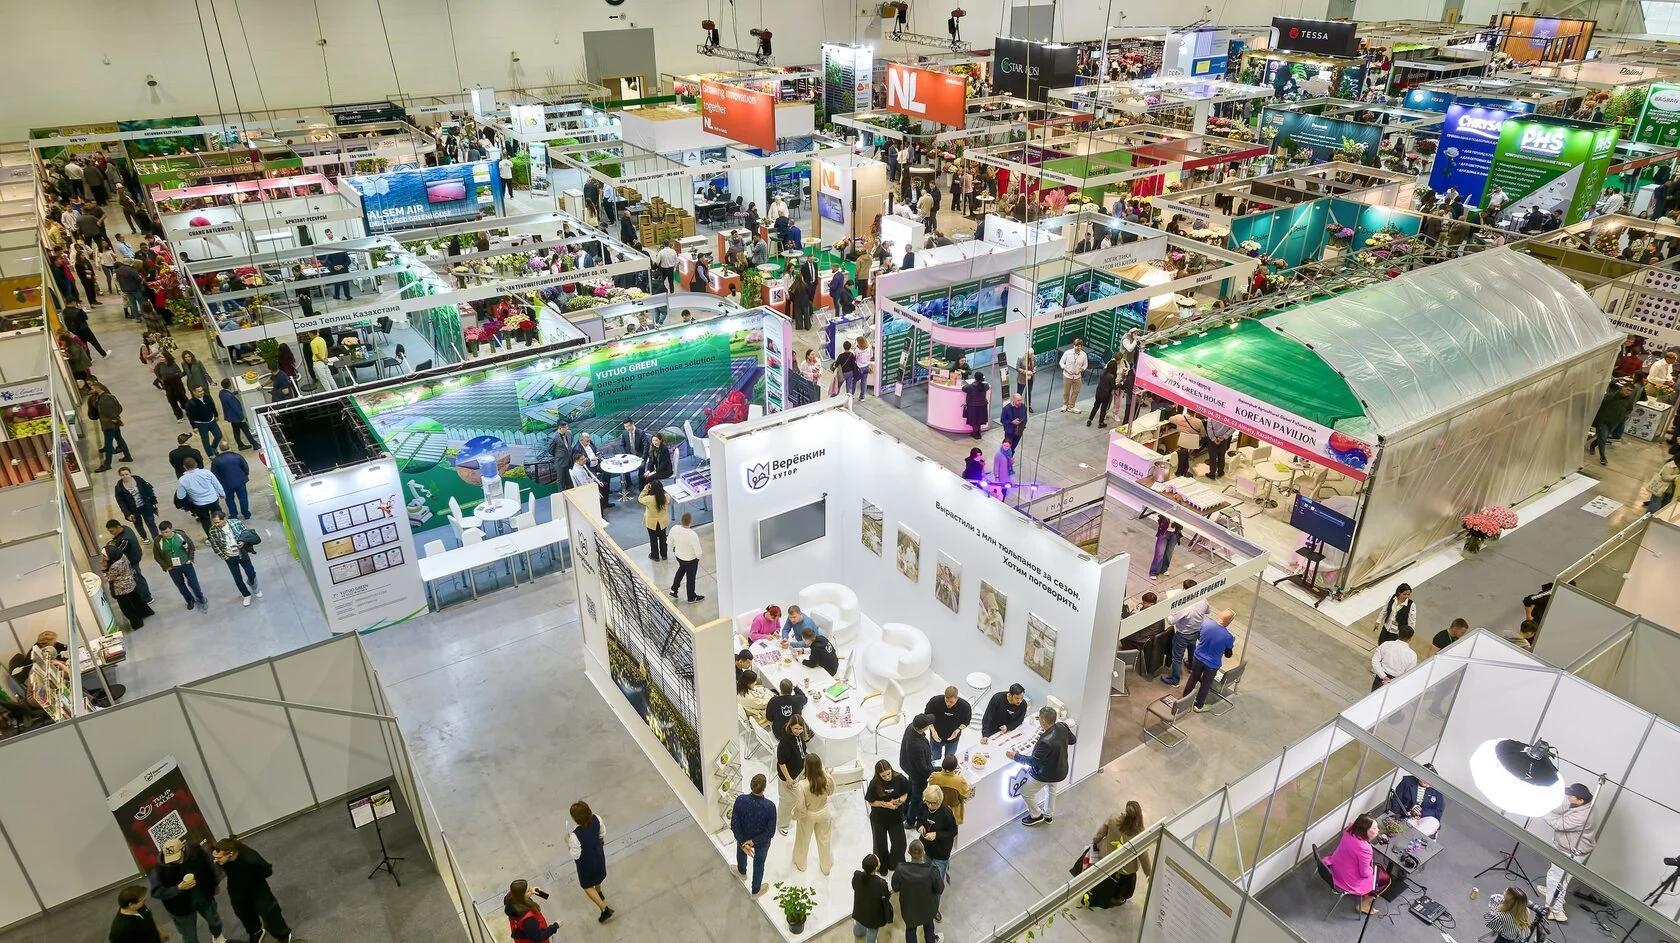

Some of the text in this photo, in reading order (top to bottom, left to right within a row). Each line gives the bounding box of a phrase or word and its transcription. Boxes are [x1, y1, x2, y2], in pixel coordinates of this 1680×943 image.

[1301, 31, 1328, 41] TESSA
[1008, 62, 1023, 73] STAR
[888, 67, 927, 115] NL
[703, 116, 714, 129] NL
[1521, 127, 1565, 151] PHS
[822, 168, 840, 191] NL
[407, 204, 424, 216] AIR
[293, 304, 401, 330] Союз Теплиц Казахстана
[595, 359, 659, 381] YUTUO GREEN
[636, 363, 683, 380] greenhouse
[684, 355, 717, 369] solution
[597, 384, 633, 399] provider
[1181, 384, 1203, 399] GREEN
[1203, 393, 1227, 409] HOUSE
[1235, 405, 1318, 447] KOREAN PAVILION
[1256, 429, 1284, 447] Kazakhstan
[772, 448, 826, 471] Верёвкин
[772, 468, 798, 480] ХУТОР
[935, 500, 1081, 602] Вырастили 3 млн тюльпанов за сезон.
[1002, 555, 1080, 614] Хотим поговорить.
[1170, 578, 1227, 610] ЯГОДНЫЕ ПРОЕКТЫ
[152, 788, 171, 804] TULIP
[154, 792, 175, 809] TALKS
